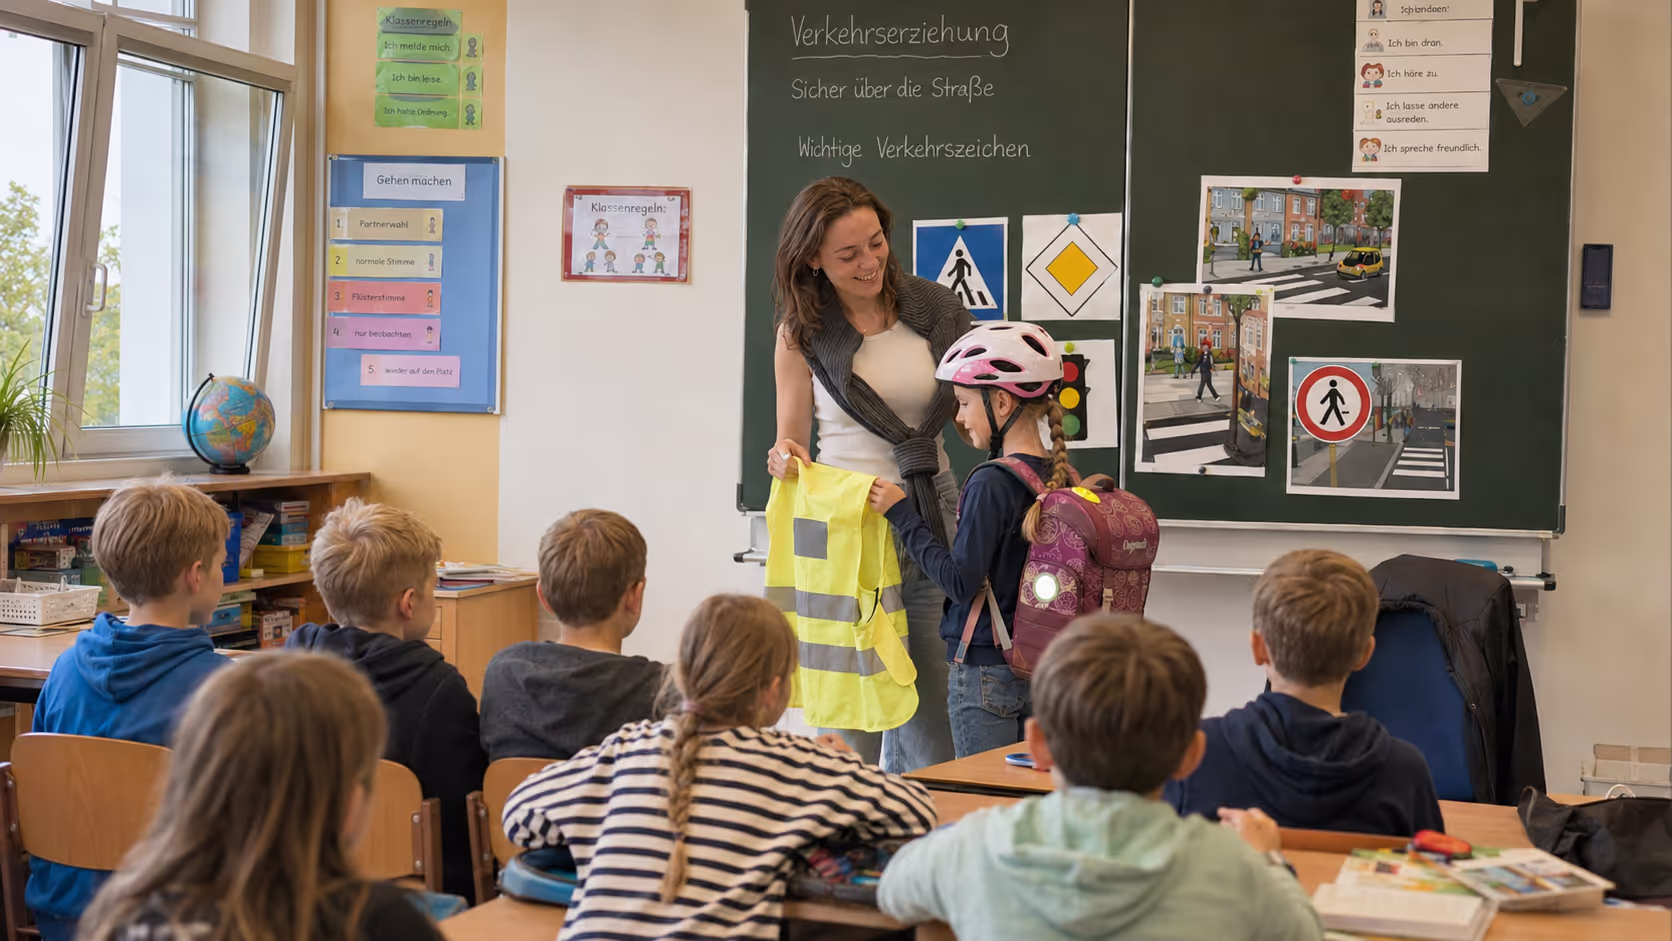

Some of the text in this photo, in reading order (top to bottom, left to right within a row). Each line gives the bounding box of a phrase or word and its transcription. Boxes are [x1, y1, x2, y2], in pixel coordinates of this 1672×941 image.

[791, 14, 1009, 57] Verkehrserziehung
[384, 41, 398, 50] Ich
[400, 42, 426, 51] melde
[1388, 38, 1443, 48] Ich bin dran.
[392, 73, 405, 82] Ich
[407, 74, 420, 82] bin
[1387, 69, 1438, 78] Ich höre zu.
[791, 75, 995, 103] Sicher über die Straße
[383, 106, 395, 115] Ich
[1386, 101, 1459, 110] Ich lasse andere
[1386, 115, 1429, 124] ausreden.
[798, 134, 1031, 168] Wichtige Verkehrszeichen
[1384, 143, 1481, 156] Ich spreche freundlich.
[376, 174, 452, 187] Gehen machen
[591, 202, 666, 216] Klassenregeln:
[336, 219, 409, 229] 1. Partnerwahl
[335, 255, 415, 266] 2. normale Stimme
[352, 292, 405, 302] Flüsterstimme
[368, 364, 376, 374] 5.
[422, 367, 435, 375] den
